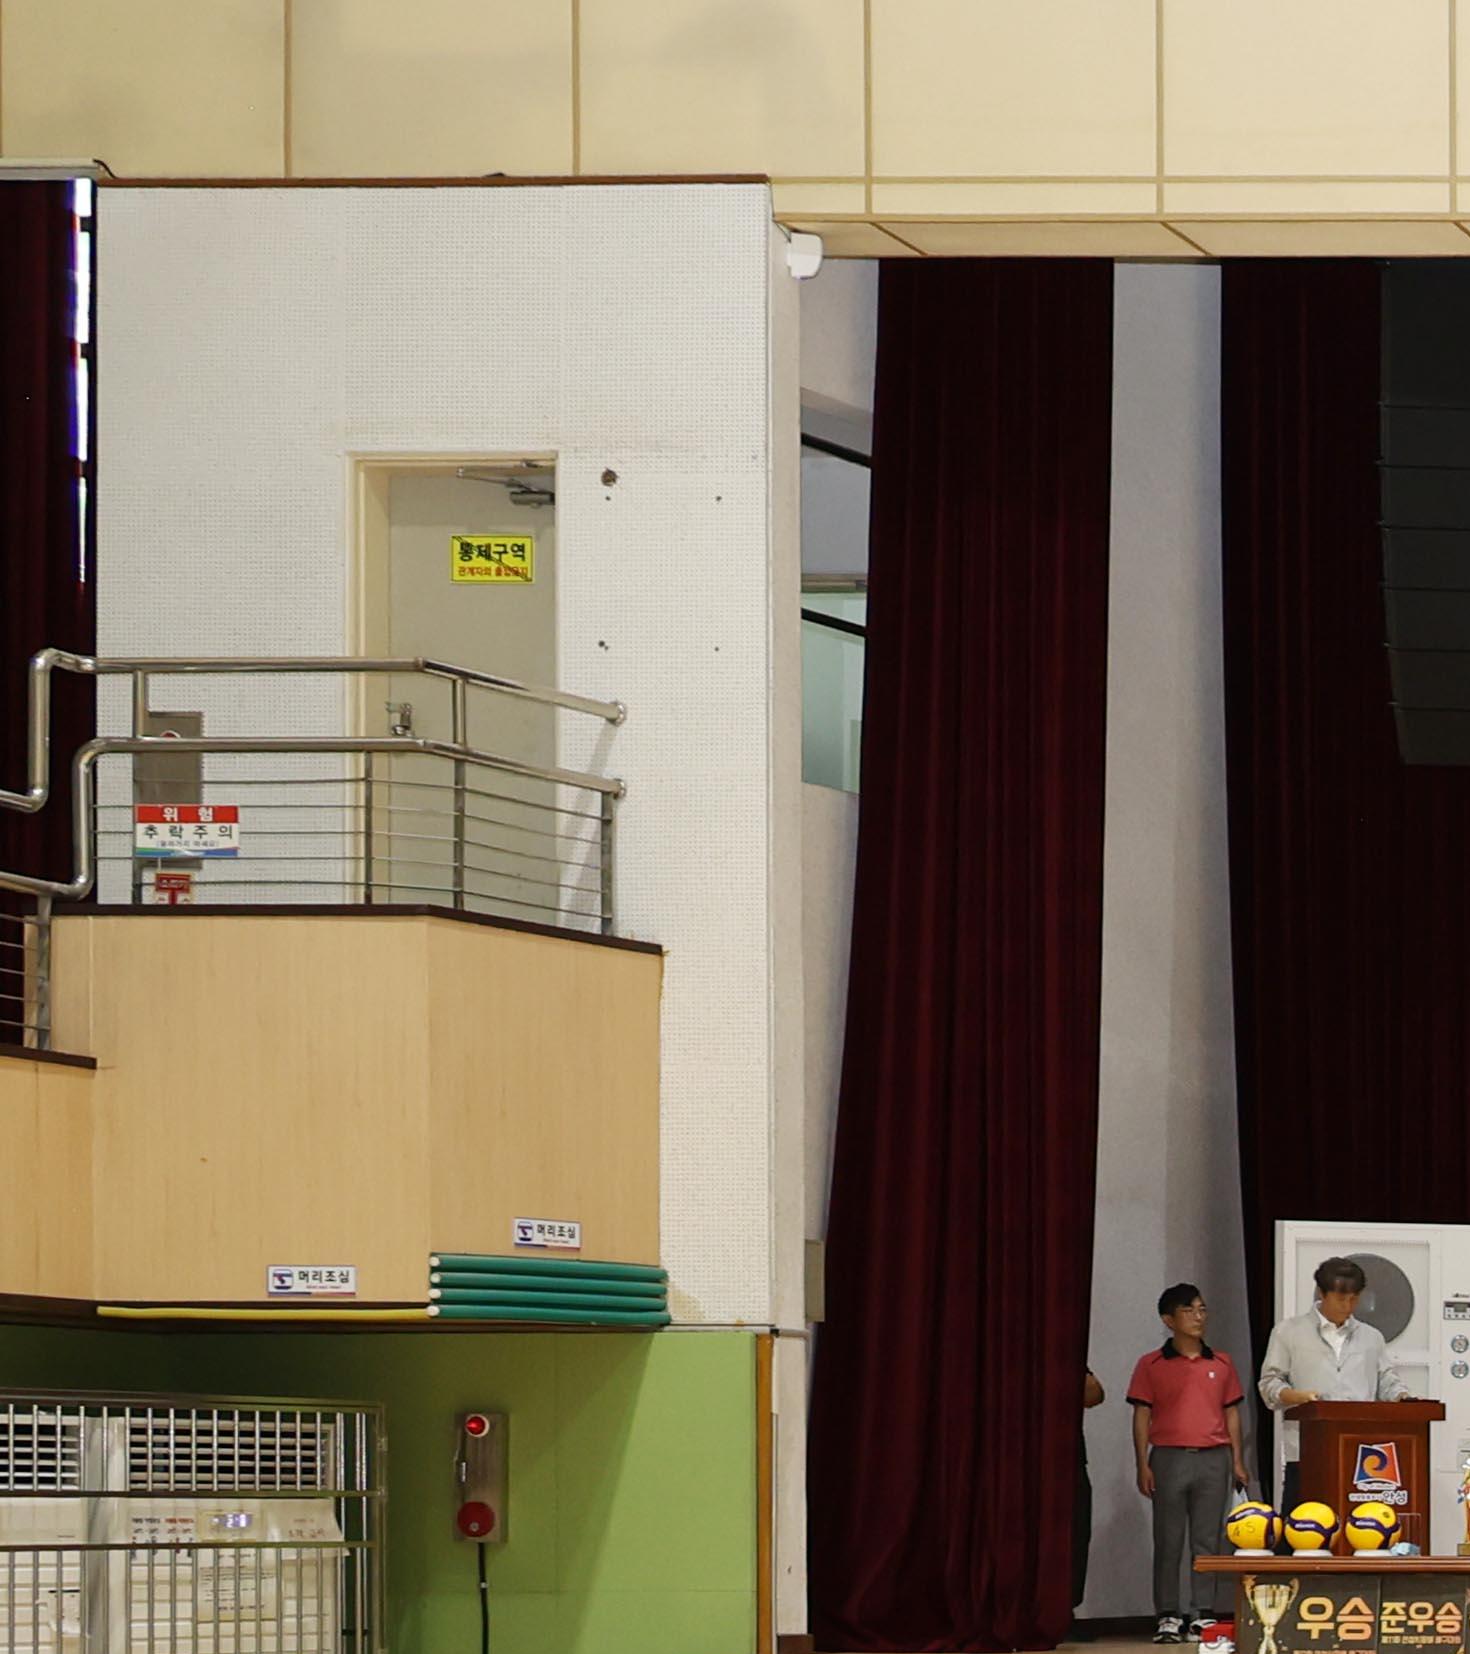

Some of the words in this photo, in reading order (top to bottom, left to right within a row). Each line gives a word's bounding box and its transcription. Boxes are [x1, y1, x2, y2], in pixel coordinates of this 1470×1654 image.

[537, 1224, 577, 1239] 머리조심
[299, 1270, 350, 1284] 머리조심
[1297, 1597, 1375, 1640] 우승
[1380, 1602, 1463, 1634] 준우승
